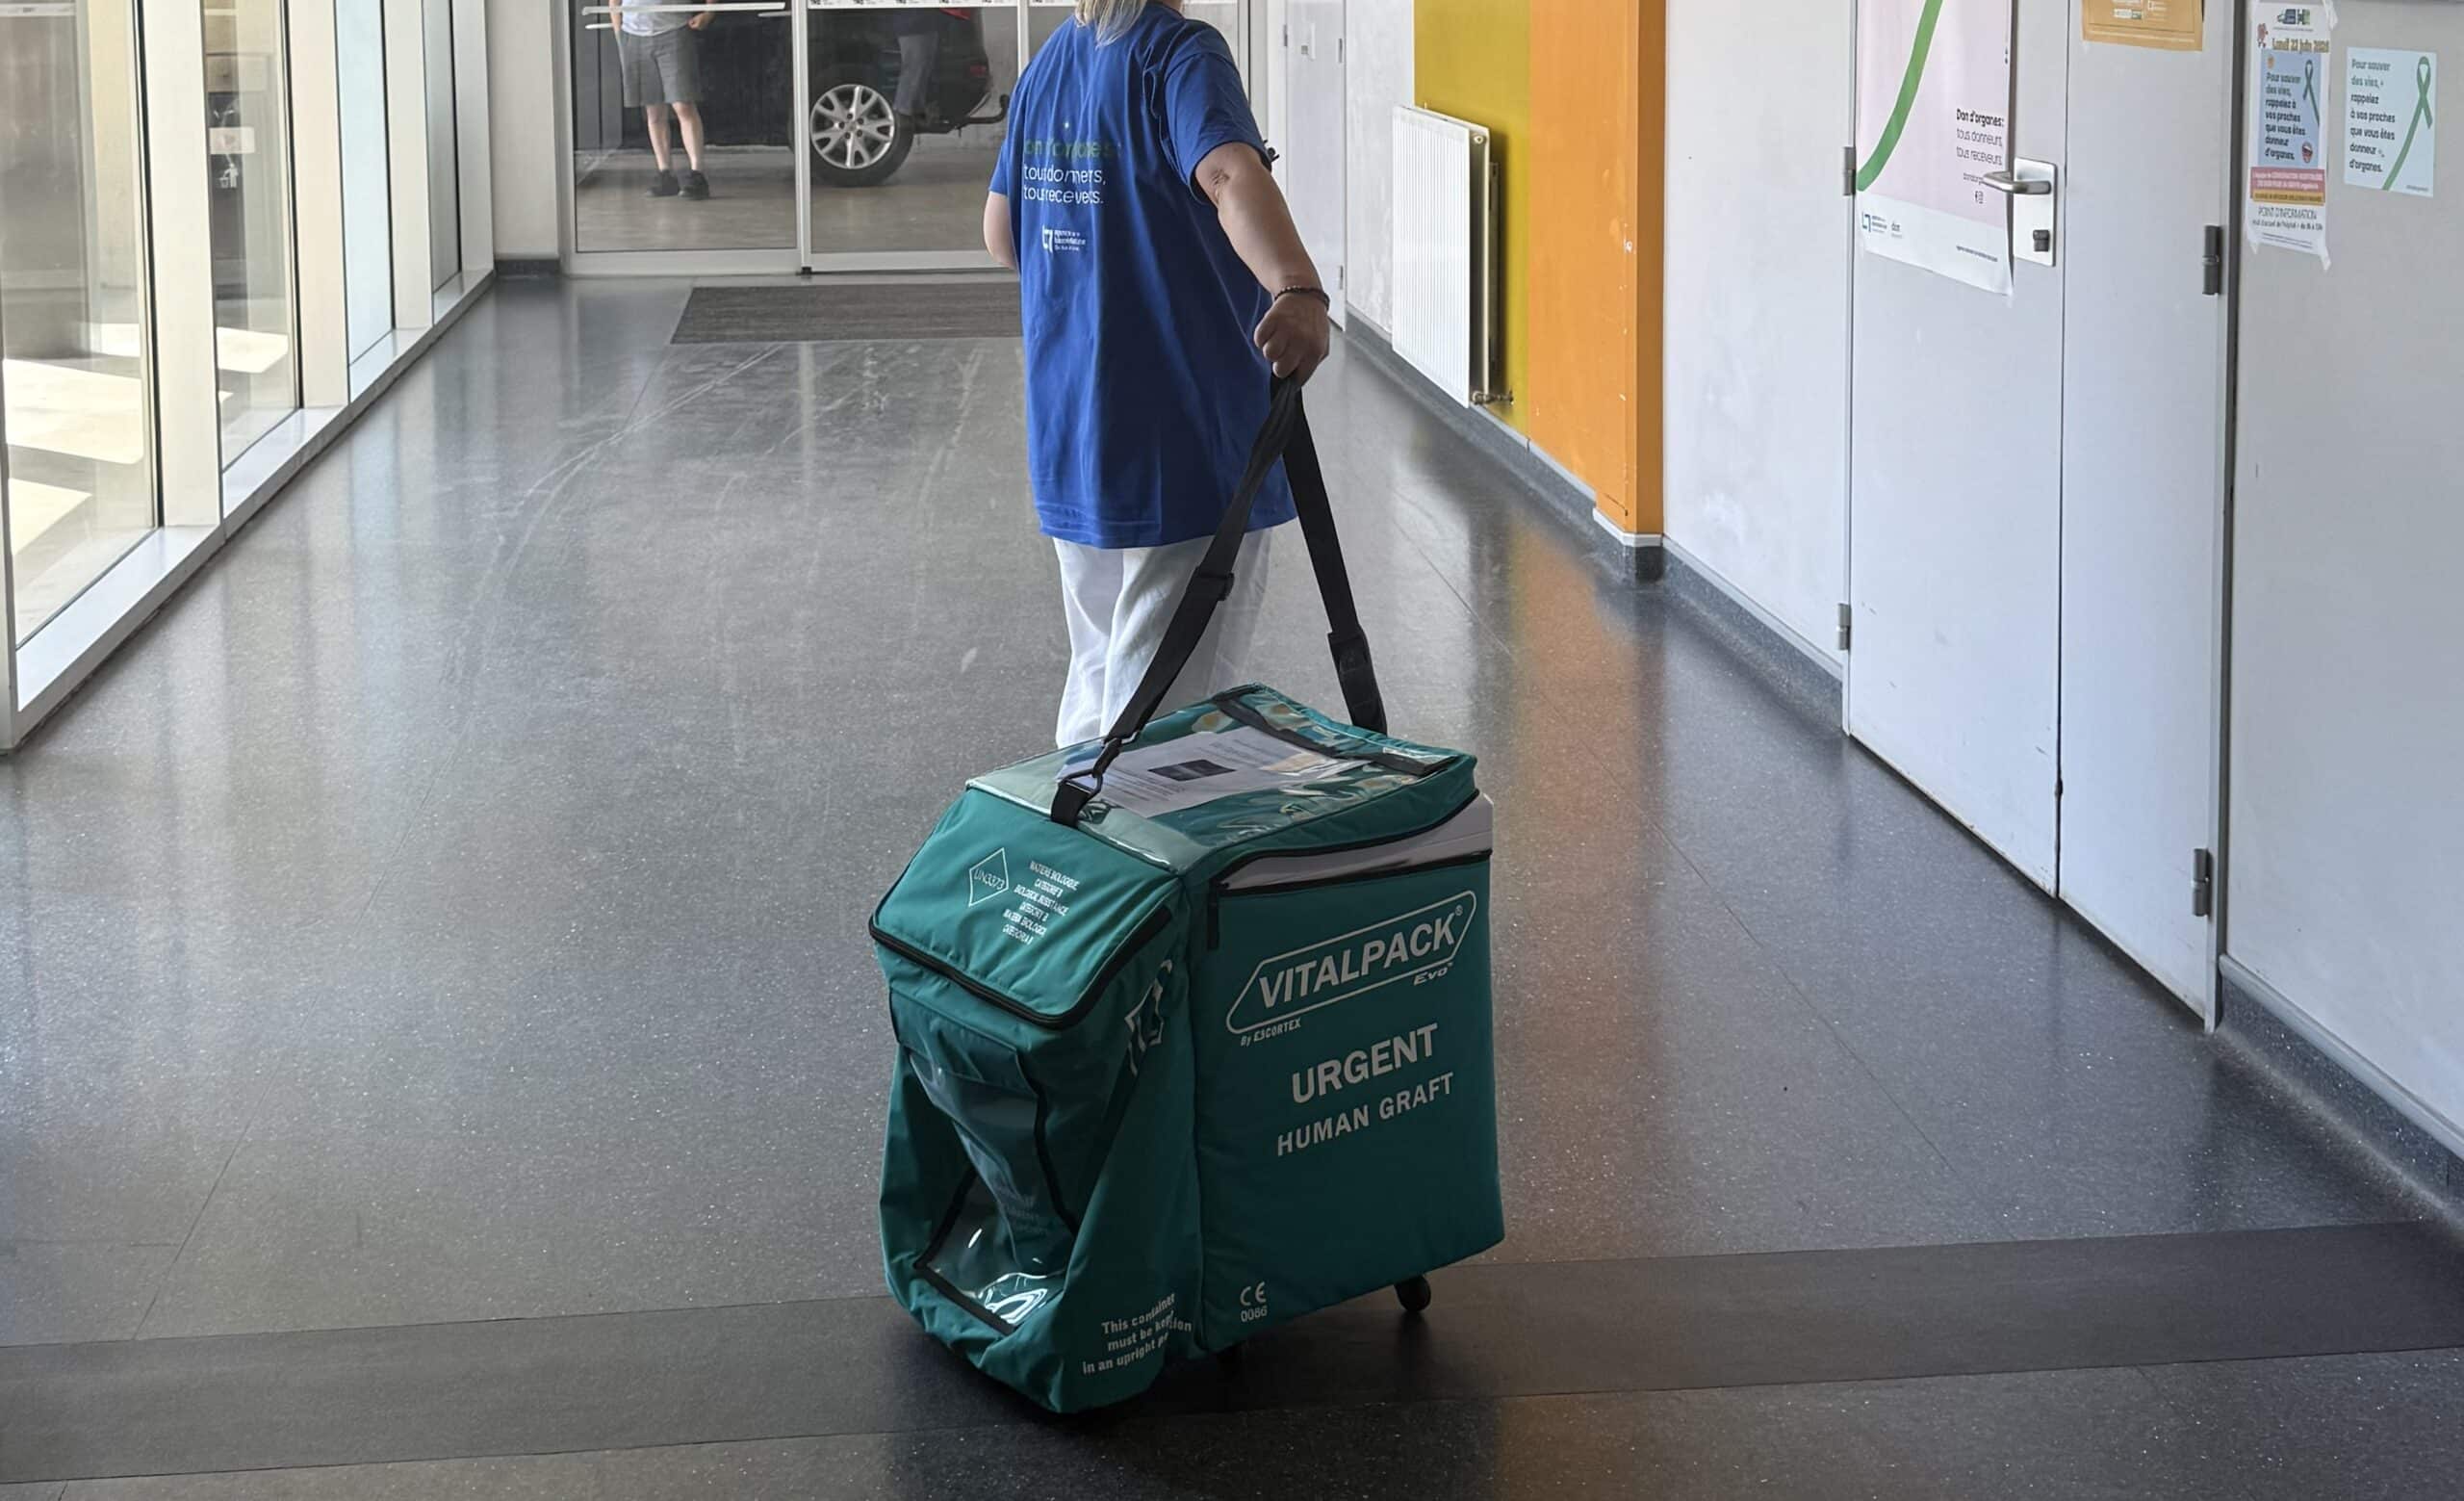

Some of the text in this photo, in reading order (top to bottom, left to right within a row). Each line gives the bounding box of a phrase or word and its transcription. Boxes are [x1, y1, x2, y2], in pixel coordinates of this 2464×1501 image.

[2351, 59, 2391, 71] Pour sauver
[2266, 72, 2279, 83] Pour
[2350, 74, 2363, 86] des
[2265, 84, 2276, 94] des
[2265, 99, 2291, 111] rappelez
[2350, 92, 2379, 106] rappelez
[1956, 108, 1968, 121] Don
[2265, 112, 2300, 122] vos proches
[2349, 107, 2396, 123] à vos proches
[1956, 128, 1970, 140] tous
[2265, 123, 2306, 136] que vous êtes
[2349, 127, 2395, 141] que vous êtes
[2265, 135, 2290, 146] donneur
[1956, 145, 1969, 159] tous
[2349, 142, 2376, 155] donneur
[2348, 159, 2383, 173] d'organes.
[974, 867, 1005, 891] UN3373
[1240, 1017, 1301, 1048] By ESCORTEX
[1292, 1022, 1438, 1103] URGENT
[1277, 1072, 1453, 1157] HUMAN GRAFT
[1101, 1292, 1175, 1334] This container
[1241, 1305, 1268, 1322] 0086
[1108, 1332, 1137, 1352] must
[1140, 1327, 1153, 1340] be
[1082, 1359, 1095, 1376] in
[1098, 1359, 1113, 1372] an
[1116, 1338, 1155, 1367] upright
